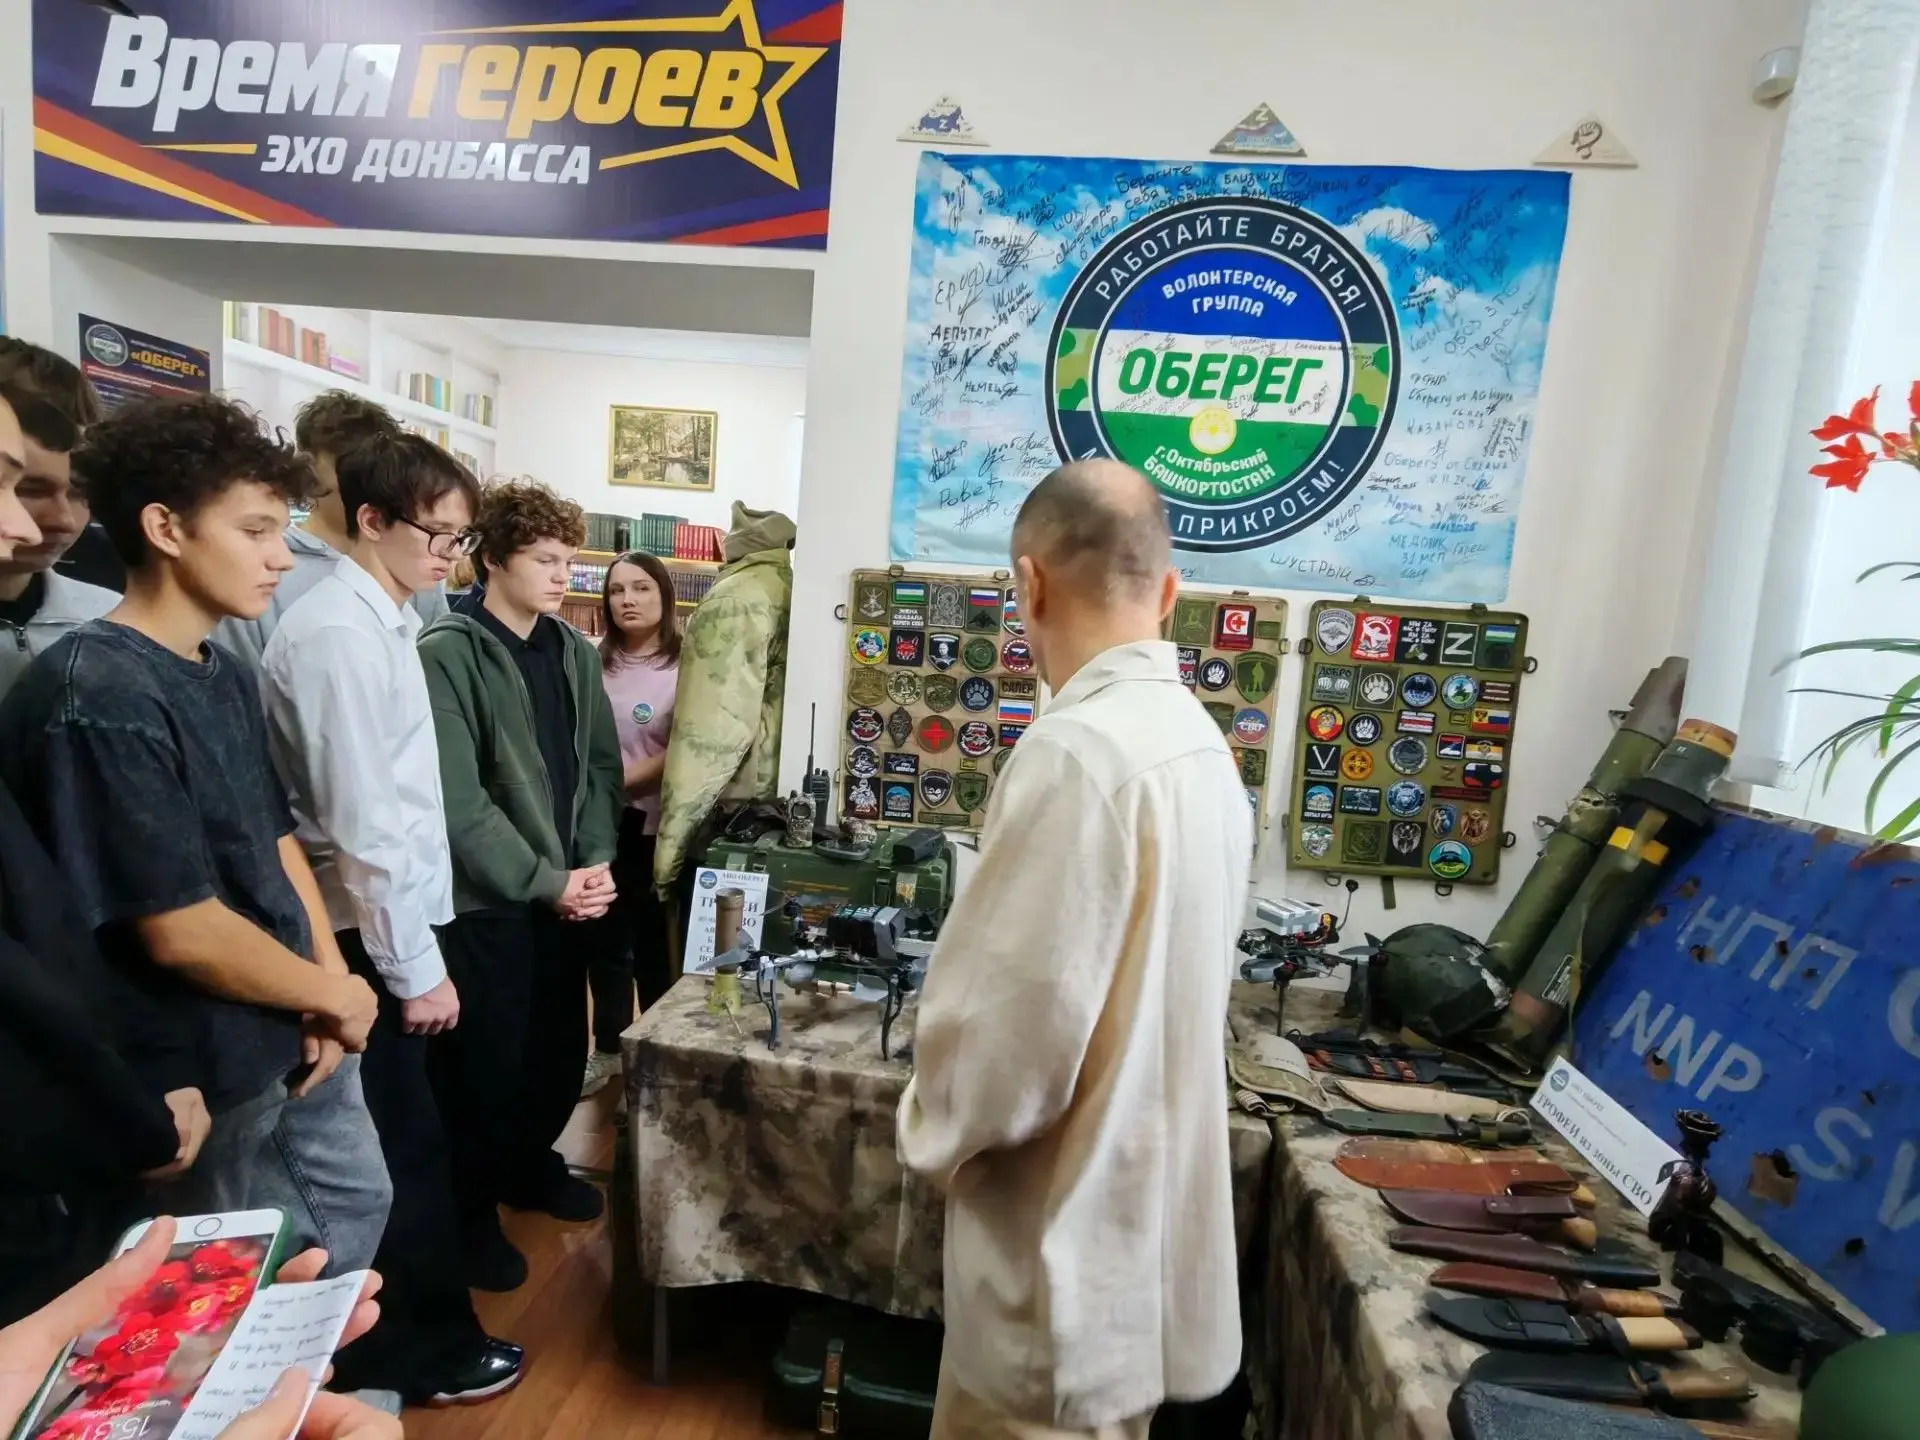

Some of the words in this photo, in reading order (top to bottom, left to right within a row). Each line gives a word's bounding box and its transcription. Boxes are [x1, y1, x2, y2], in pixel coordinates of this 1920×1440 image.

[92, 14, 401, 131] Время
[408, 44, 768, 139] героев
[261, 134, 343, 178] ЭХО
[352, 139, 591, 185] ДОНБАССА
[1095, 213, 1251, 300] РАБОТАЙТЕ
[1271, 224, 1367, 315] БРАТЬЯ!
[1162, 269, 1297, 306] ВОЛОНТЕРСКАЯ
[1192, 295, 1264, 318] ГРУППА
[131, 350, 205, 377] «ОБЕРЕГ»
[1119, 348, 1324, 404] ОБЕРЕГ
[1144, 456, 1276, 496] БАШКОРТОСТАН
[1178, 460, 1345, 536] ПРИКРОЕМ!
[1444, 632, 1473, 656] Z
[1002, 680, 1034, 694] САПЕР
[1610, 989, 1763, 1101] NNP
[1537, 1093, 1581, 1142] ТРОФЕИ
[1580, 1136, 1591, 1151] из
[1593, 1150, 1620, 1179] зоны
[1623, 1174, 1653, 1206] СВО
